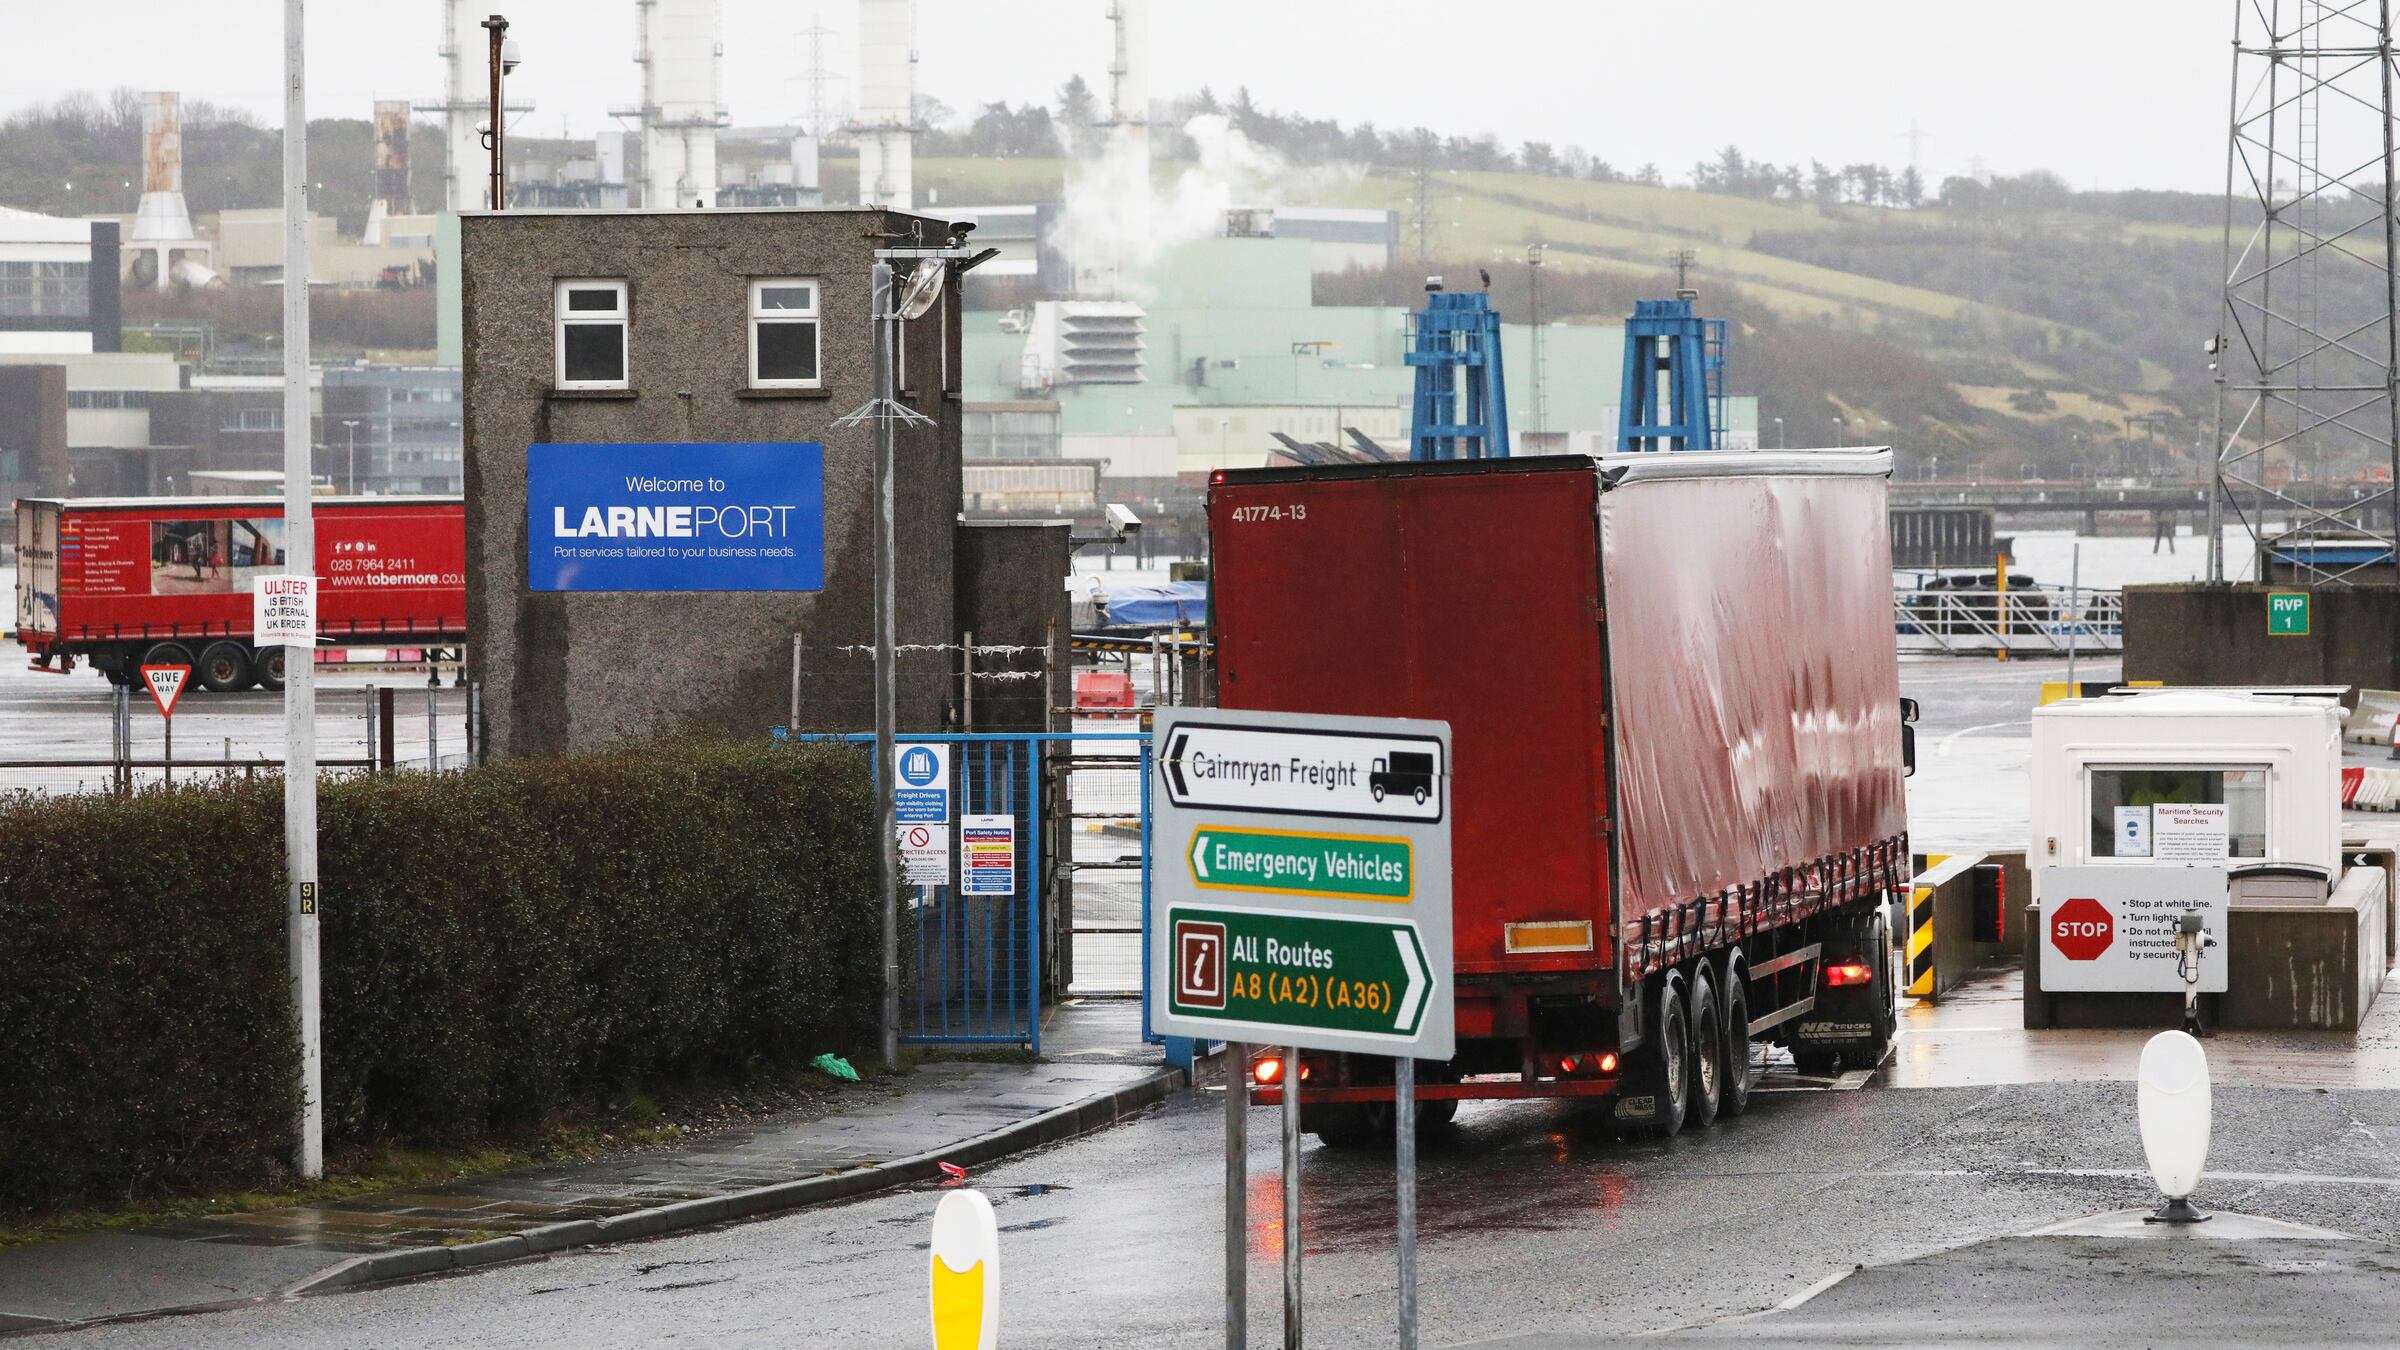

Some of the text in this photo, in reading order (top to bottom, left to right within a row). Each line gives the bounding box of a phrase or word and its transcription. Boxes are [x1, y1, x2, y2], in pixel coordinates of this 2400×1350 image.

[626, 476, 725, 492] Welcome to
[1232, 504, 1306, 522] 41774-13
[554, 505, 796, 538] LARNEPORT
[554, 546, 797, 560] Port services tailored to your business needs.
[330, 558, 415, 572] 028 7964 2411
[264, 579, 308, 595] ULSTER
[269, 596, 278, 606] IS
[2274, 598, 2303, 611] RVP
[264, 607, 277, 618] NO
[266, 619, 306, 630] UK BRDER
[2284, 616, 2291, 629] 1
[152, 672, 179, 683] GIVE
[157, 685, 175, 693] WAY
[1192, 751, 1357, 791] Cairnryan Freight
[897, 792, 918, 800] Freight
[2192, 808, 2224, 817] Security
[1215, 843, 1403, 882] Emergency Vehicles
[302, 883, 312, 897] 9
[303, 899, 312, 913] R
[2129, 900, 2213, 909] Stop at white line.
[2129, 913, 2178, 923] Turn lights
[2056, 922, 2108, 937] STOP
[2129, 939, 2177, 947] instructed
[1232, 935, 1333, 969] All Routes
[2129, 950, 2140, 960] by
[2143, 950, 2180, 960] security
[1232, 972, 1391, 1014] A8 (A2) (A36)
[1798, 1022, 1834, 1033] NR
